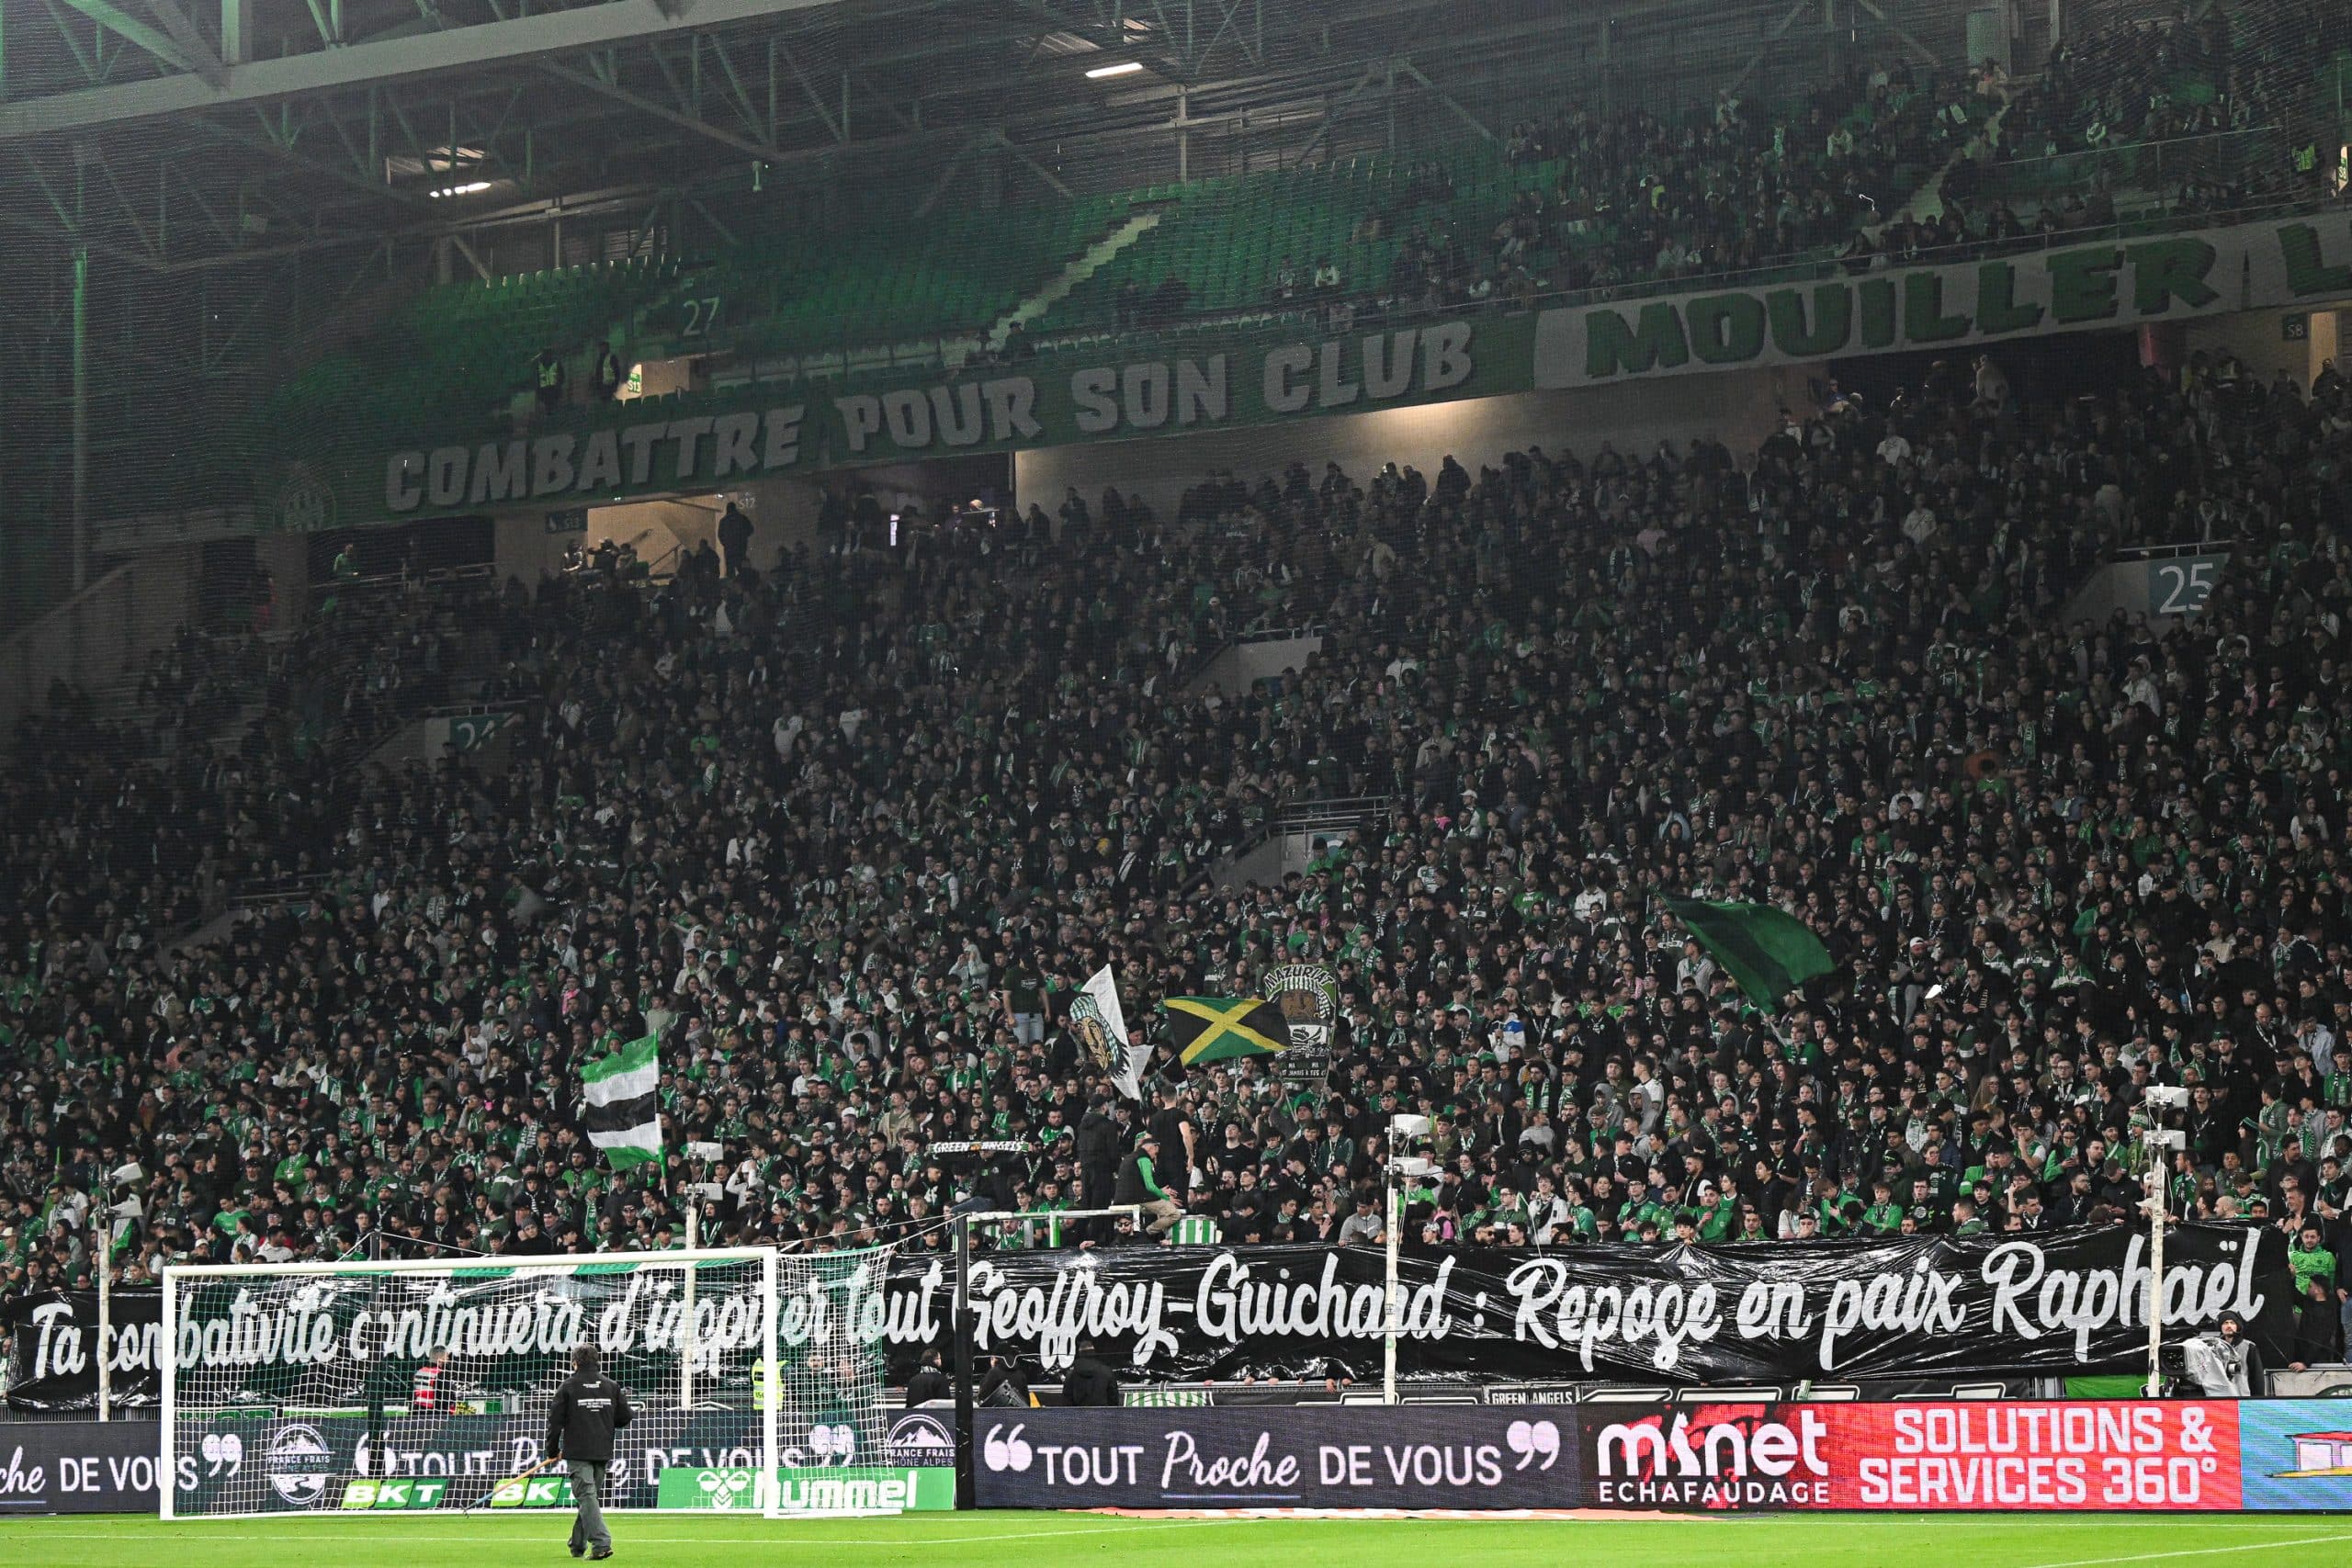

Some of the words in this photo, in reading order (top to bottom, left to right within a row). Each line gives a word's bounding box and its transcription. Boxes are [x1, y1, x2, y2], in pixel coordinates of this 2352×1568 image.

[683, 297, 729, 336] 27
[1584, 236, 2221, 378] MOUILLER
[385, 404, 806, 512] COMBATTRE
[835, 375, 1045, 451] POUR
[1072, 354, 1227, 433] SON
[1263, 320, 1472, 412] CLUB
[2159, 562, 2214, 615] 25
[933, 1142, 970, 1153] GREEN
[32, 1303, 85, 1379] Ta
[845, 1259, 940, 1344] tout
[1736, 1279, 1812, 1339] en
[1819, 1256, 1966, 1371] paix
[1982, 1227, 2265, 1363] Raphaël
[1491, 1392, 1525, 1404] GREEN
[1532, 1391, 1573, 1404] ANGELS
[1894, 1406, 2165, 1454] SOLUTIONS
[2179, 1406, 2217, 1454] &
[922, 1458, 954, 1467] ALPES
[926, 1448, 956, 1458] FRAIS
[1037, 1446, 1144, 1486] TOUT
[1161, 1430, 1300, 1489] Proche
[1320, 1446, 1372, 1485] DE
[1384, 1445, 1503, 1486] VOUS
[60, 1457, 100, 1492] DE
[344, 1484, 444, 1503] BKT
[753, 1470, 917, 1508] hummel
[1600, 1482, 1829, 1503] ECHAFAUDAGE
[1860, 1458, 2086, 1504] SERVICES
[2102, 1457, 2217, 1504] 360°
